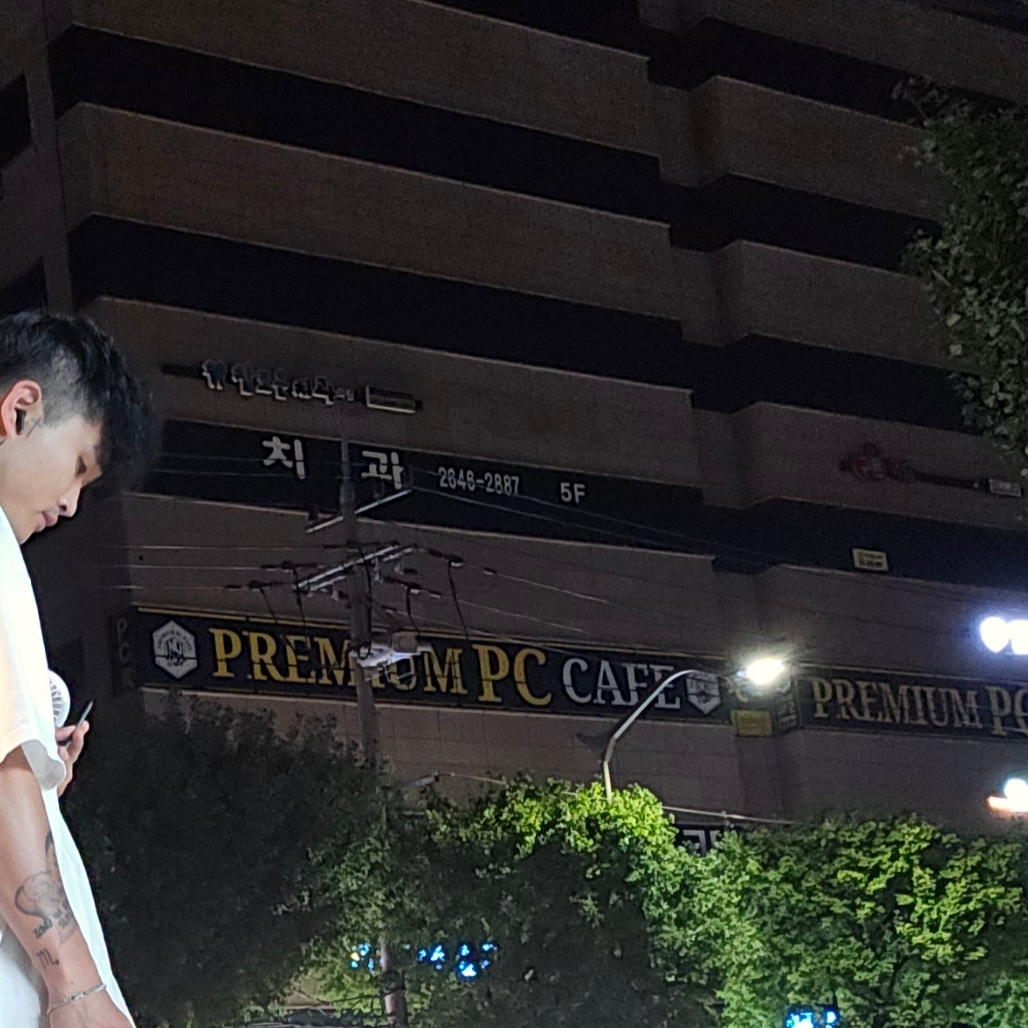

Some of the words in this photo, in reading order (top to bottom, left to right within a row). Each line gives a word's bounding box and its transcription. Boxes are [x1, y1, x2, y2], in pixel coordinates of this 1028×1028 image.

[559, 481, 587, 504] 5F
[472, 643, 552, 707] PC
[562, 657, 681, 709] CAFE
[810, 677, 984, 730] PREMIUM
